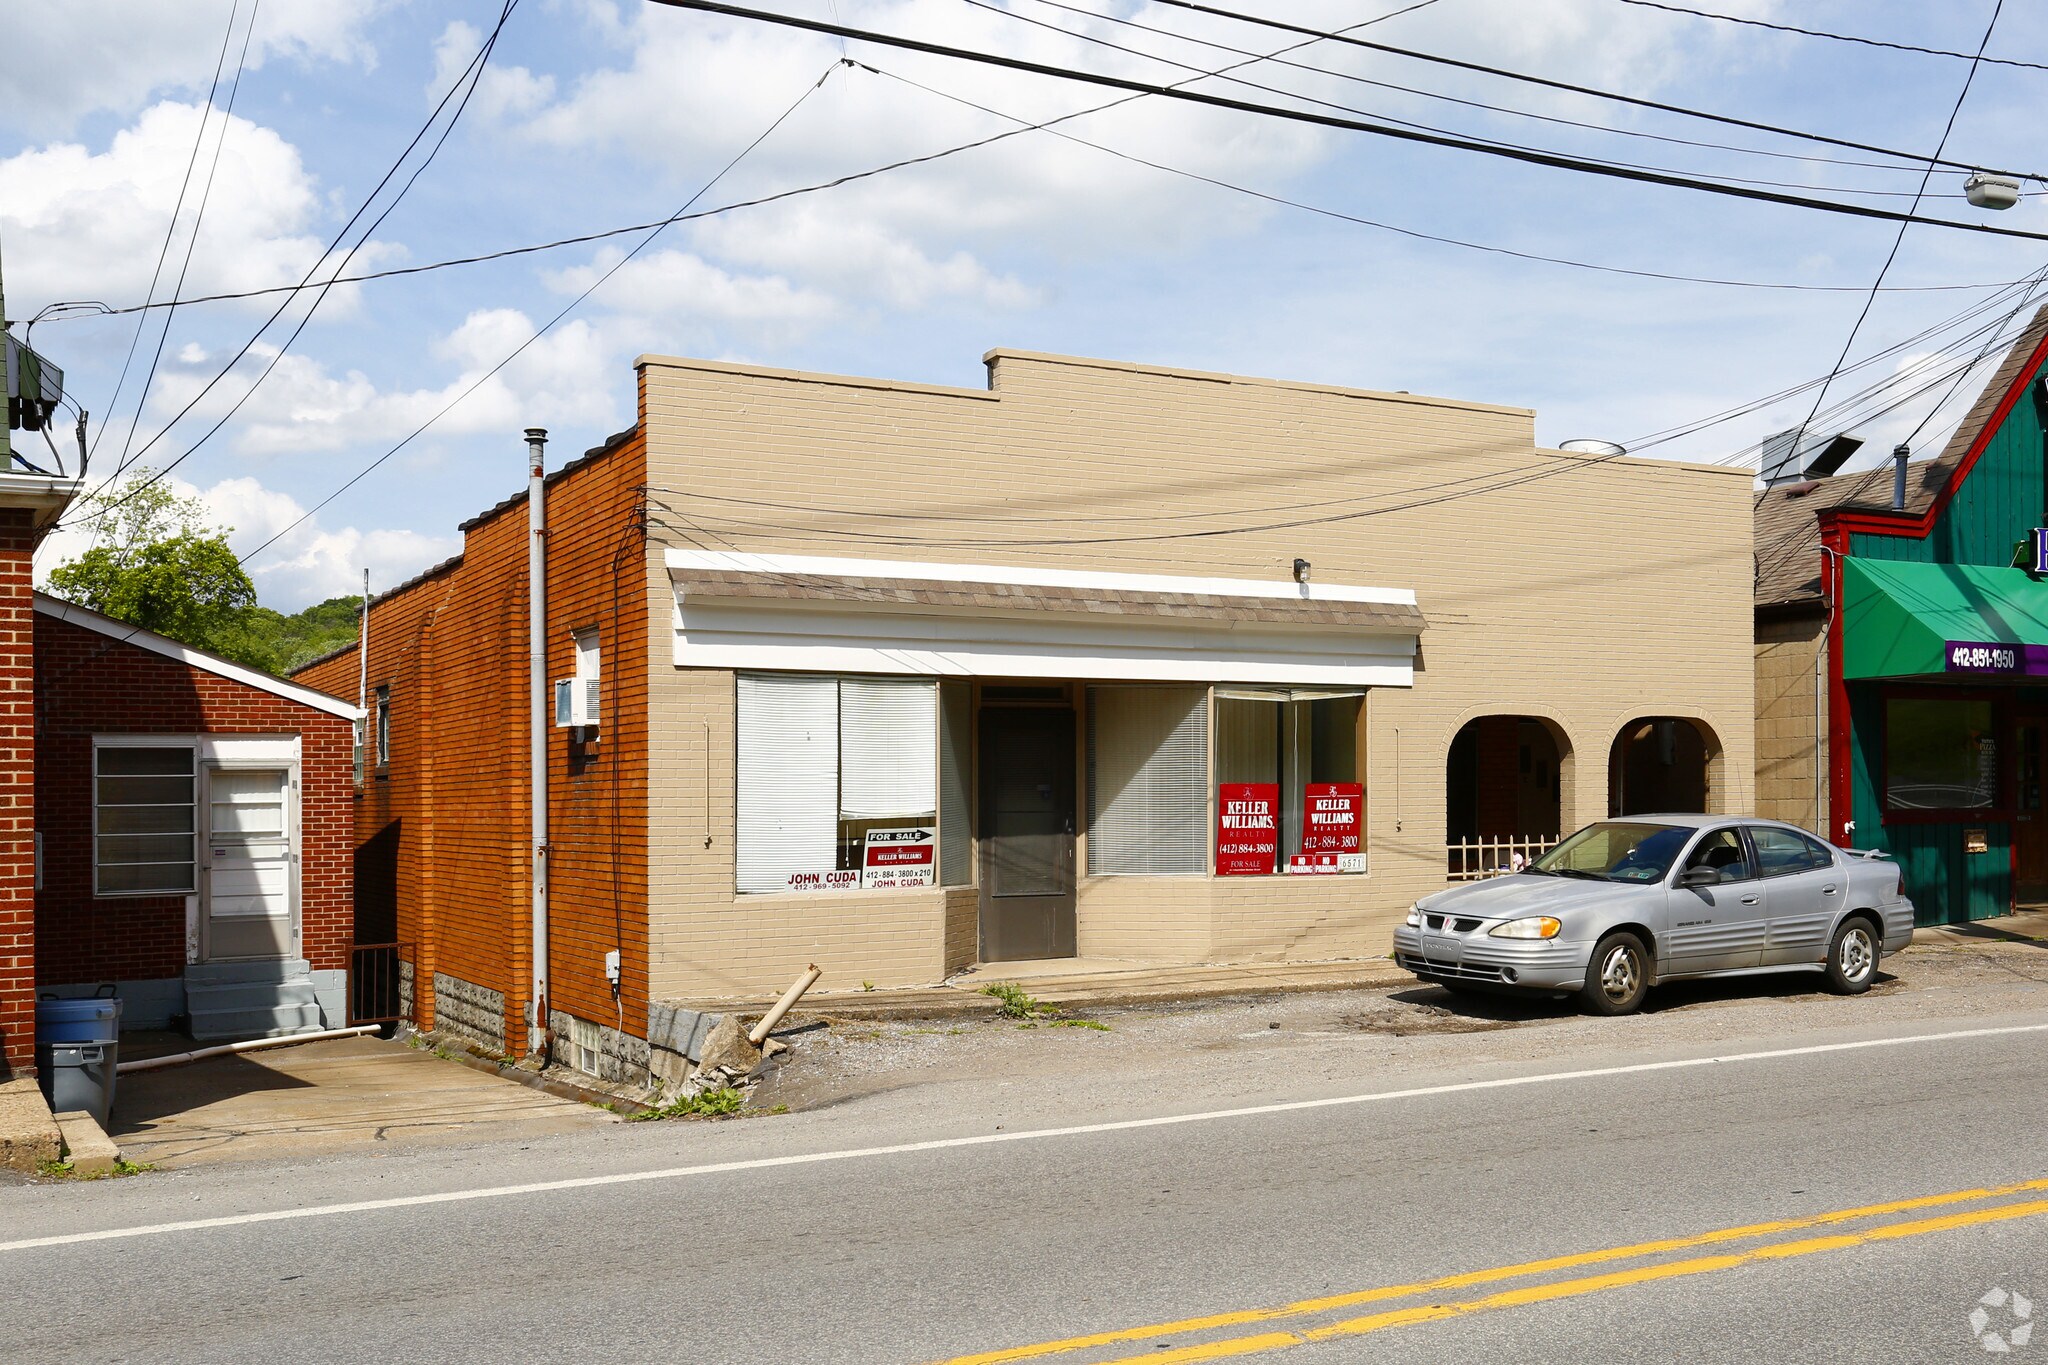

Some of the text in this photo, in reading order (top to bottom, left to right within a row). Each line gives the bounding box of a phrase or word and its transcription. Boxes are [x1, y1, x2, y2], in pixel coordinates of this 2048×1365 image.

[1952, 647, 2015, 669] 412-851-1950
[1227, 801, 1269, 815] KELLER
[1316, 799, 1351, 811] KELLER
[1310, 812, 1354, 824] WILLIAMS
[870, 832, 921, 841] FOR SALE
[1229, 830, 1266, 838] REALTY
[1219, 843, 1274, 854] (412) 884-3800
[1230, 860, 1261, 868] FOR SALE
[788, 871, 857, 885] JOHN CUDA
[871, 878, 924, 888] JOHN CUDA
